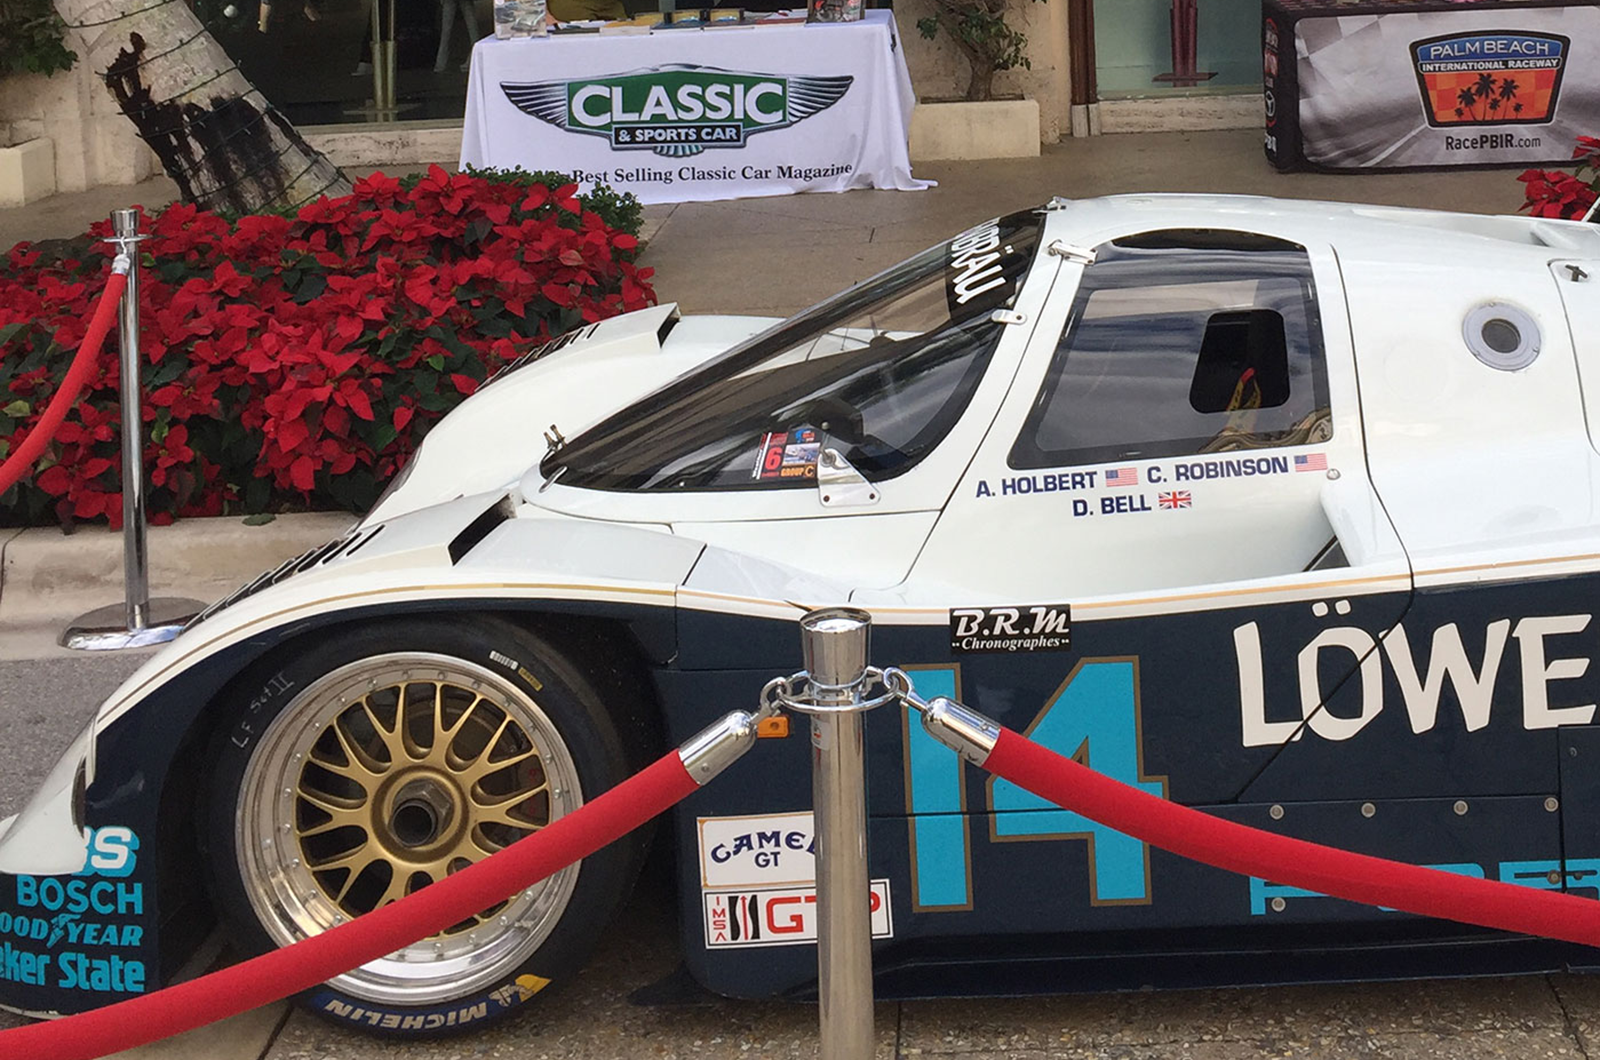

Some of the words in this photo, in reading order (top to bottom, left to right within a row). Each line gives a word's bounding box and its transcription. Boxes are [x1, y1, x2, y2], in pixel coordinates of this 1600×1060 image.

[1430, 41, 1480, 60] PALM
[1484, 40, 1549, 55] BEACH
[1422, 61, 1505, 72] INTERNATIONAL
[1508, 59, 1559, 69] RACEWAY
[571, 82, 784, 127] CLASSIC
[618, 130, 631, 142] &
[635, 128, 697, 142] SPORTS
[701, 127, 738, 140] CAR
[1445, 133, 1541, 150] RacePBIR.com
[573, 169, 609, 183] Best
[614, 167, 673, 183] Selling
[678, 165, 737, 180] Classic
[742, 164, 772, 179] Car
[776, 163, 853, 181] Magazine
[765, 446, 783, 470] 6
[1147, 466, 1167, 484] C.
[1175, 456, 1289, 482] ROBINSON
[805, 465, 815, 477] C
[976, 480, 996, 498] A.
[1001, 471, 1097, 496] HOLBERT
[1073, 498, 1094, 517] D.
[1101, 494, 1152, 515] BELL
[952, 606, 1070, 637] B.R.M
[961, 635, 1060, 651] Chronographes
[1233, 599, 1597, 748] LÖWE
[902, 655, 1169, 914] 14
[711, 831, 815, 864] CAME
[755, 851, 781, 868] GT
[16, 874, 144, 915] BOSCH
[0, 942, 50, 986] ker
[58, 952, 146, 993] State
[325, 999, 488, 1030] MICHELIN
